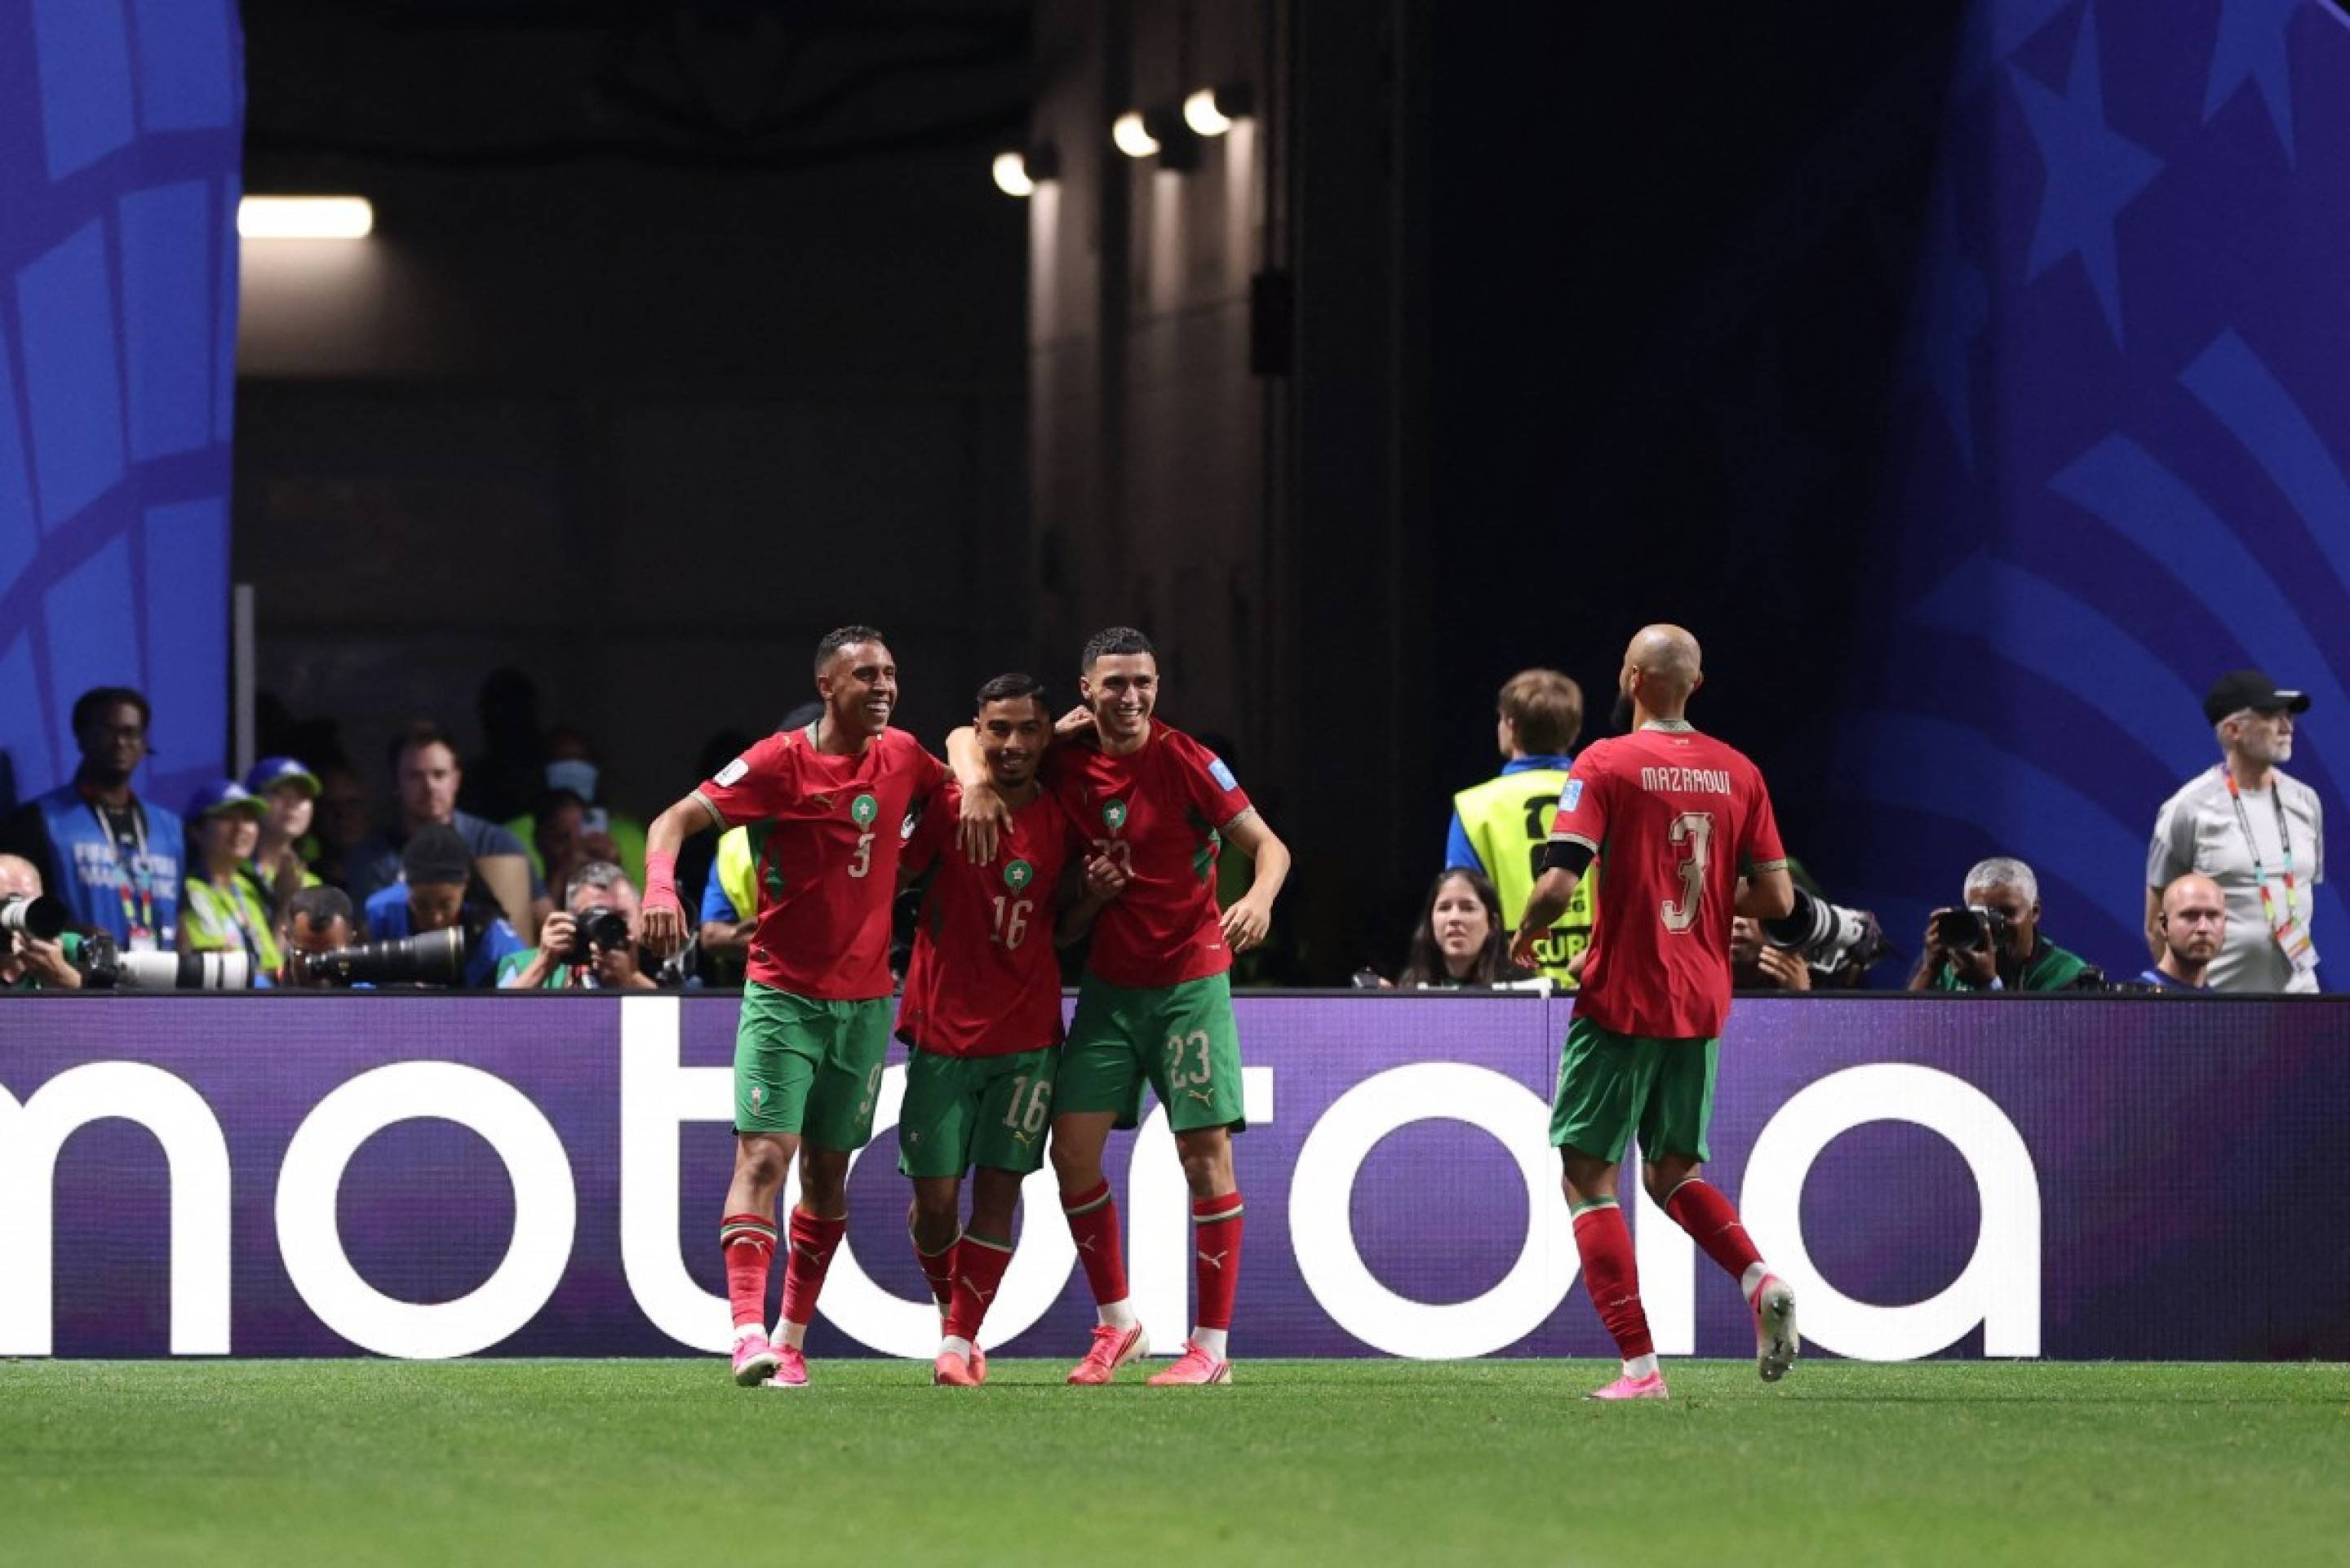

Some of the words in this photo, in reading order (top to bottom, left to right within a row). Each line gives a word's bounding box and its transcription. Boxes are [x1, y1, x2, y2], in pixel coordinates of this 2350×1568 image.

[1641, 767, 1731, 795] MAZRAOUI
[1661, 812, 1714, 933] 3
[990, 896, 1033, 950] 16
[1167, 1030, 1211, 1089] 23
[1002, 1076, 1053, 1132] 16
